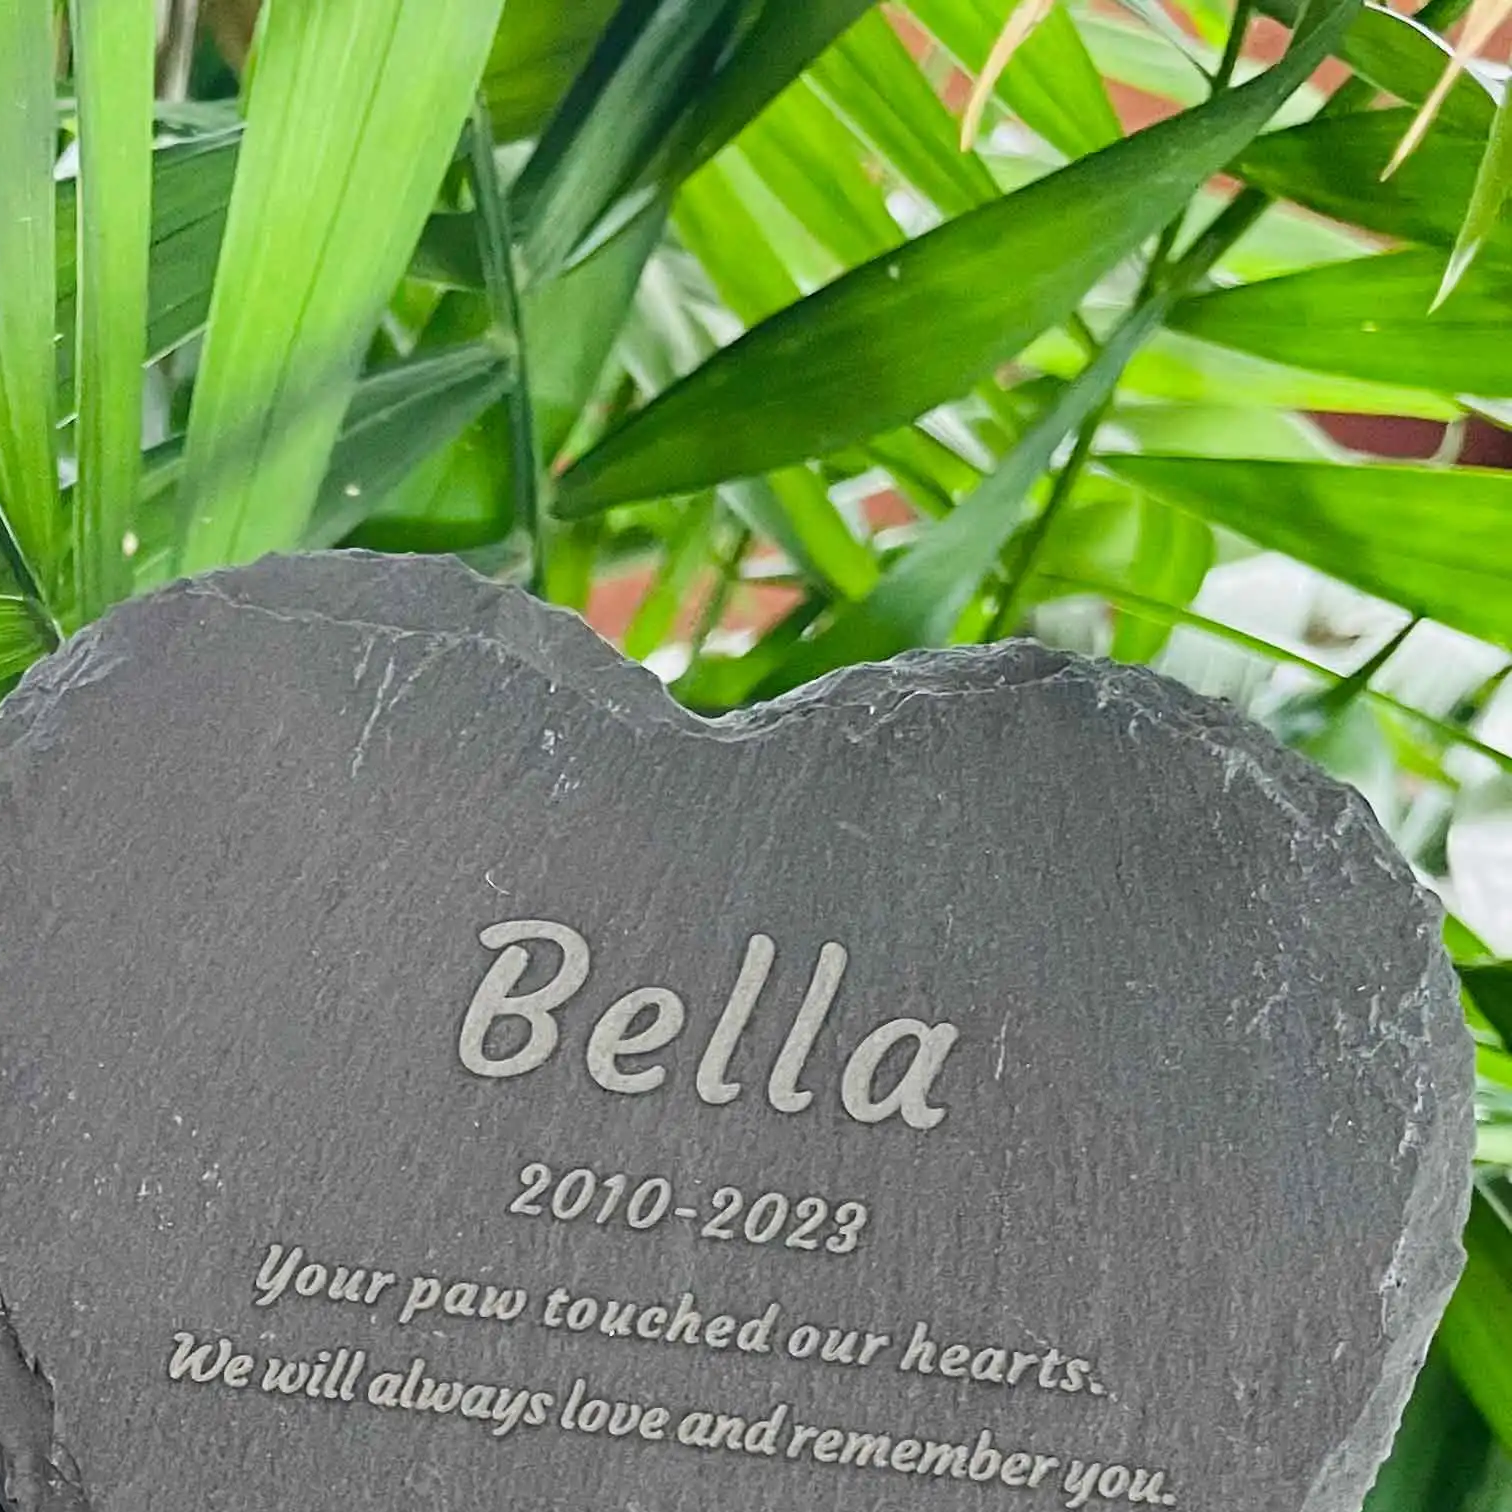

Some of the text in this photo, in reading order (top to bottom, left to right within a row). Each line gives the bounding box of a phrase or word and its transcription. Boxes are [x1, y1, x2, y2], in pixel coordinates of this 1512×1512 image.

[457, 919, 959, 1129] Bella
[509, 1162, 869, 1255] 2010-2023
[254, 1244, 1108, 1397] Your paw touched our hearts.
[168, 1333, 1178, 1508] We will always love and remember you.
